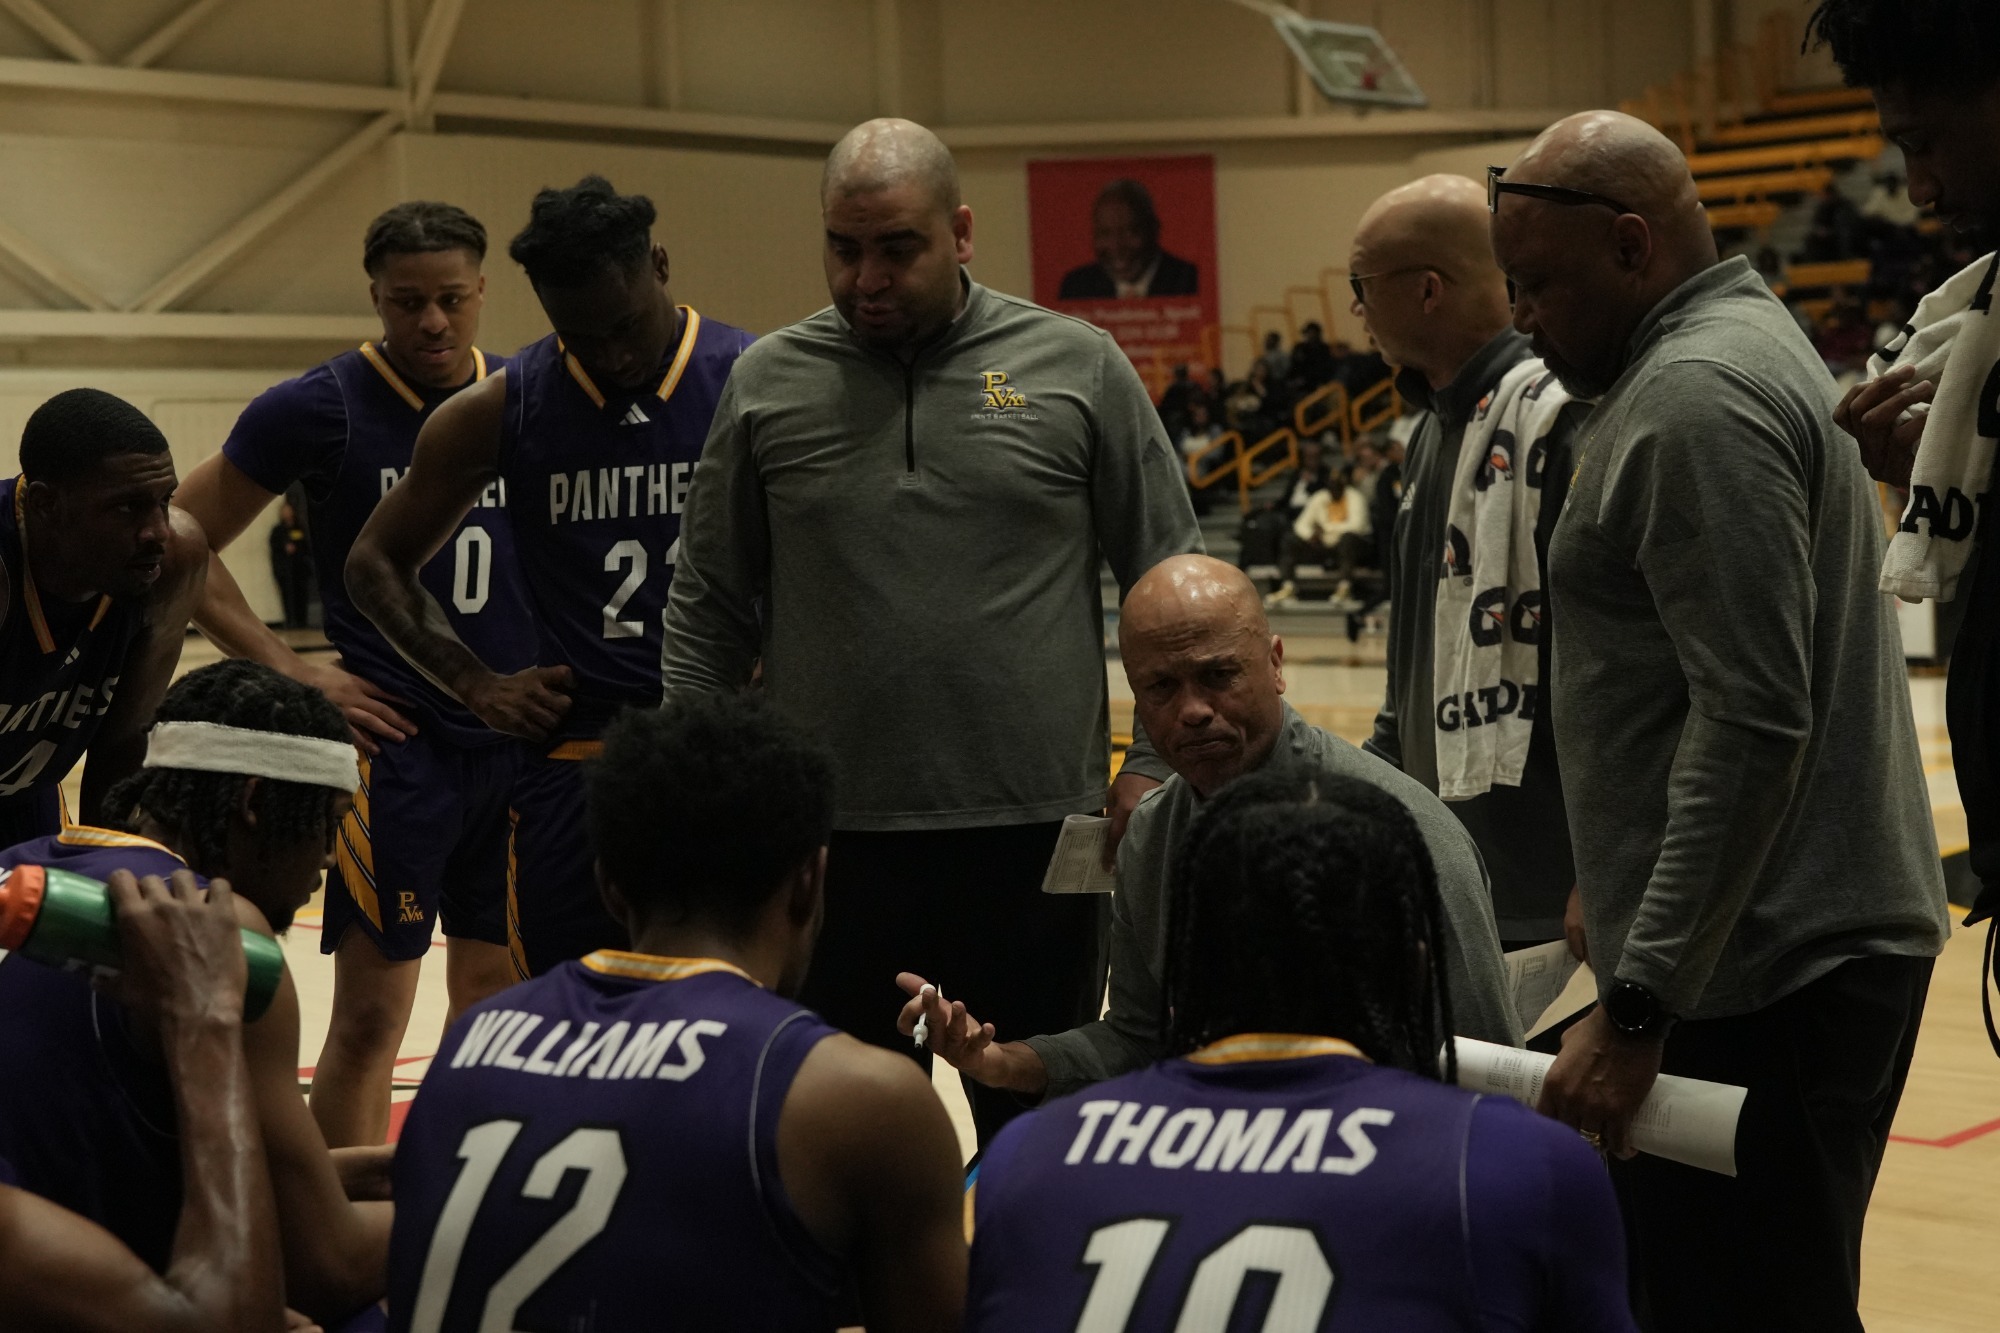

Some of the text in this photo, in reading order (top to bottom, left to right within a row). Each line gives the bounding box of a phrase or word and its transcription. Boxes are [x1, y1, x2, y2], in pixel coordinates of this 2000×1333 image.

[550, 461, 700, 526] PANTHE
[452, 525, 493, 615] 0
[602, 536, 681, 639] 2
[450, 1009, 728, 1082] WILLIAMS
[1063, 1099, 1396, 1176] THOMAS
[408, 1118, 629, 1333] 12
[1074, 1217, 1336, 1333] 10
